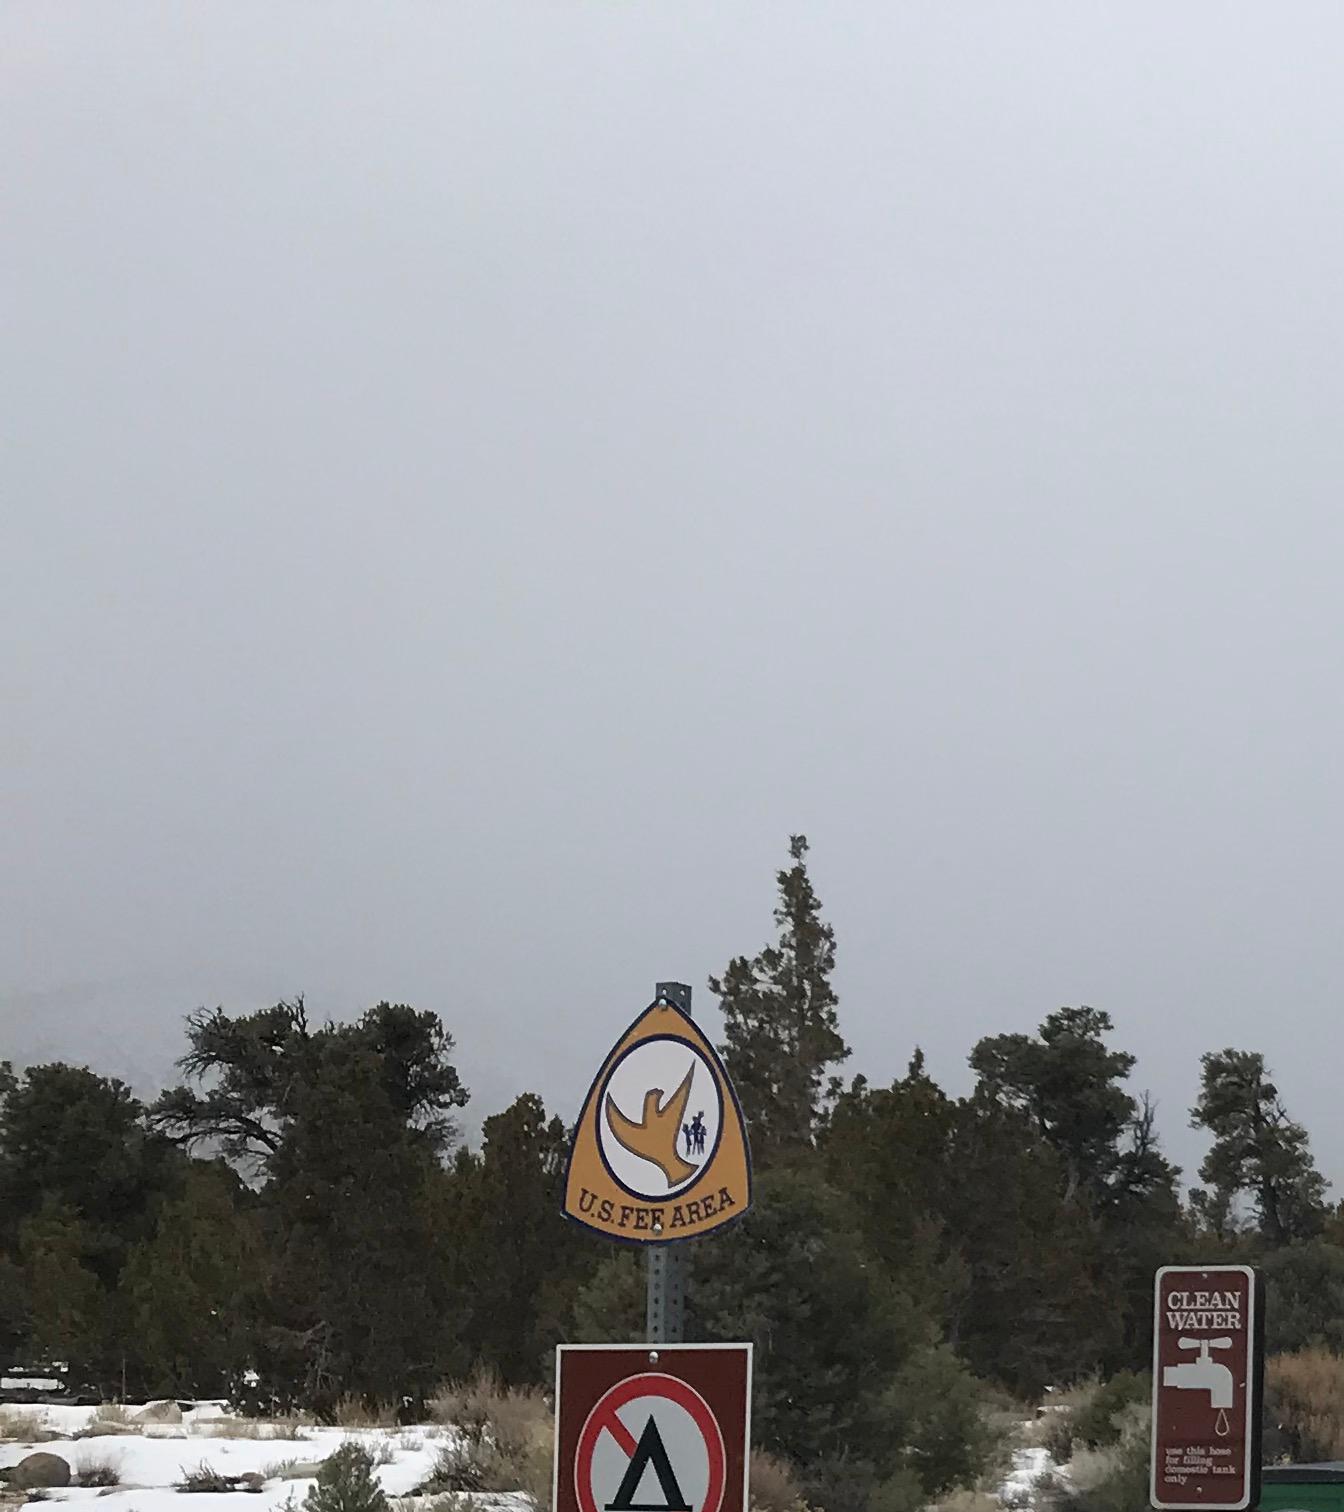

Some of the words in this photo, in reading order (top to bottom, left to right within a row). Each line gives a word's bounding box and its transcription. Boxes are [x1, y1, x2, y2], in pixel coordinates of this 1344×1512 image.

[579, 1188, 615, 1224] U.S.
[618, 1204, 665, 1230] FEE
[669, 1187, 735, 1228] AREA
[1167, 1291, 1241, 1309] CLEAN
[1166, 1311, 1242, 1330] WATER
[1186, 1446, 1205, 1455] this
[1212, 1464, 1236, 1474] tank
[1164, 1474, 1188, 1485] only
